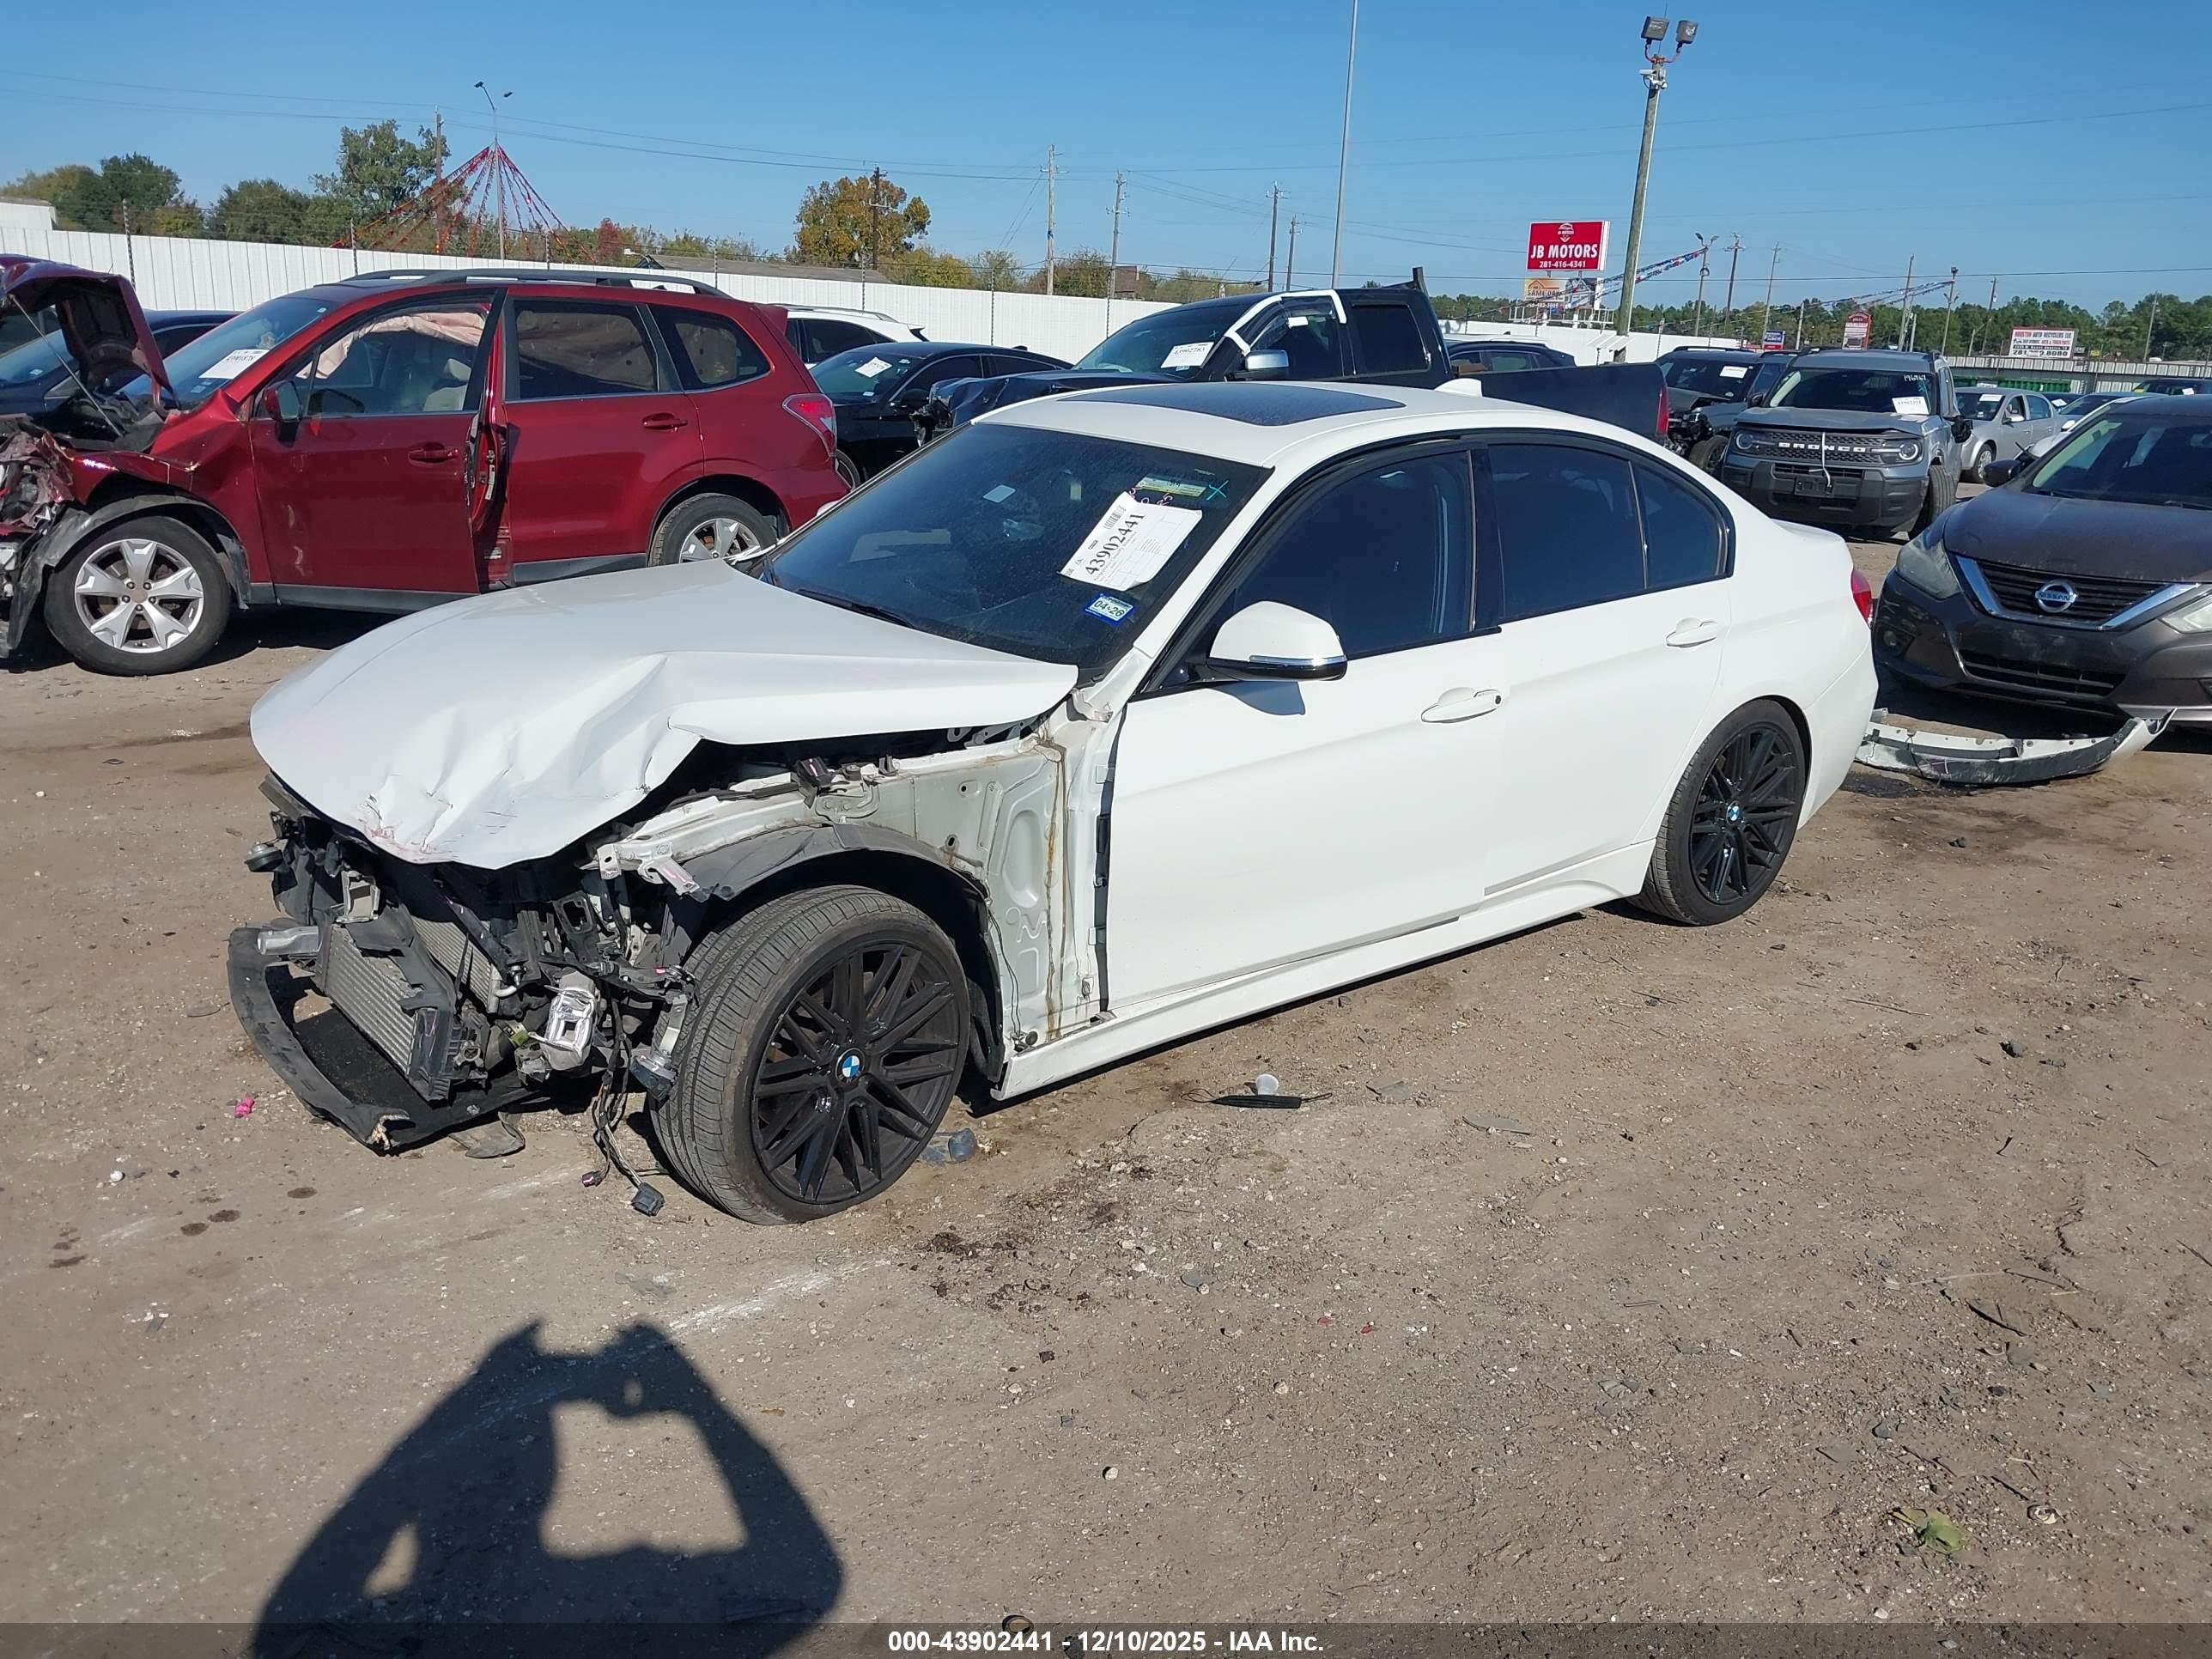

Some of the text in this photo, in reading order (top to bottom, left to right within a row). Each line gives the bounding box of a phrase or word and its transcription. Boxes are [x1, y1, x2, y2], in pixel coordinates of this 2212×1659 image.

[1531, 243, 1598, 258] JB MOTORS
[1778, 442, 1866, 453] BRONCO
[1085, 514, 1146, 574] 43902441
[2039, 591, 2070, 601] NISSAN
